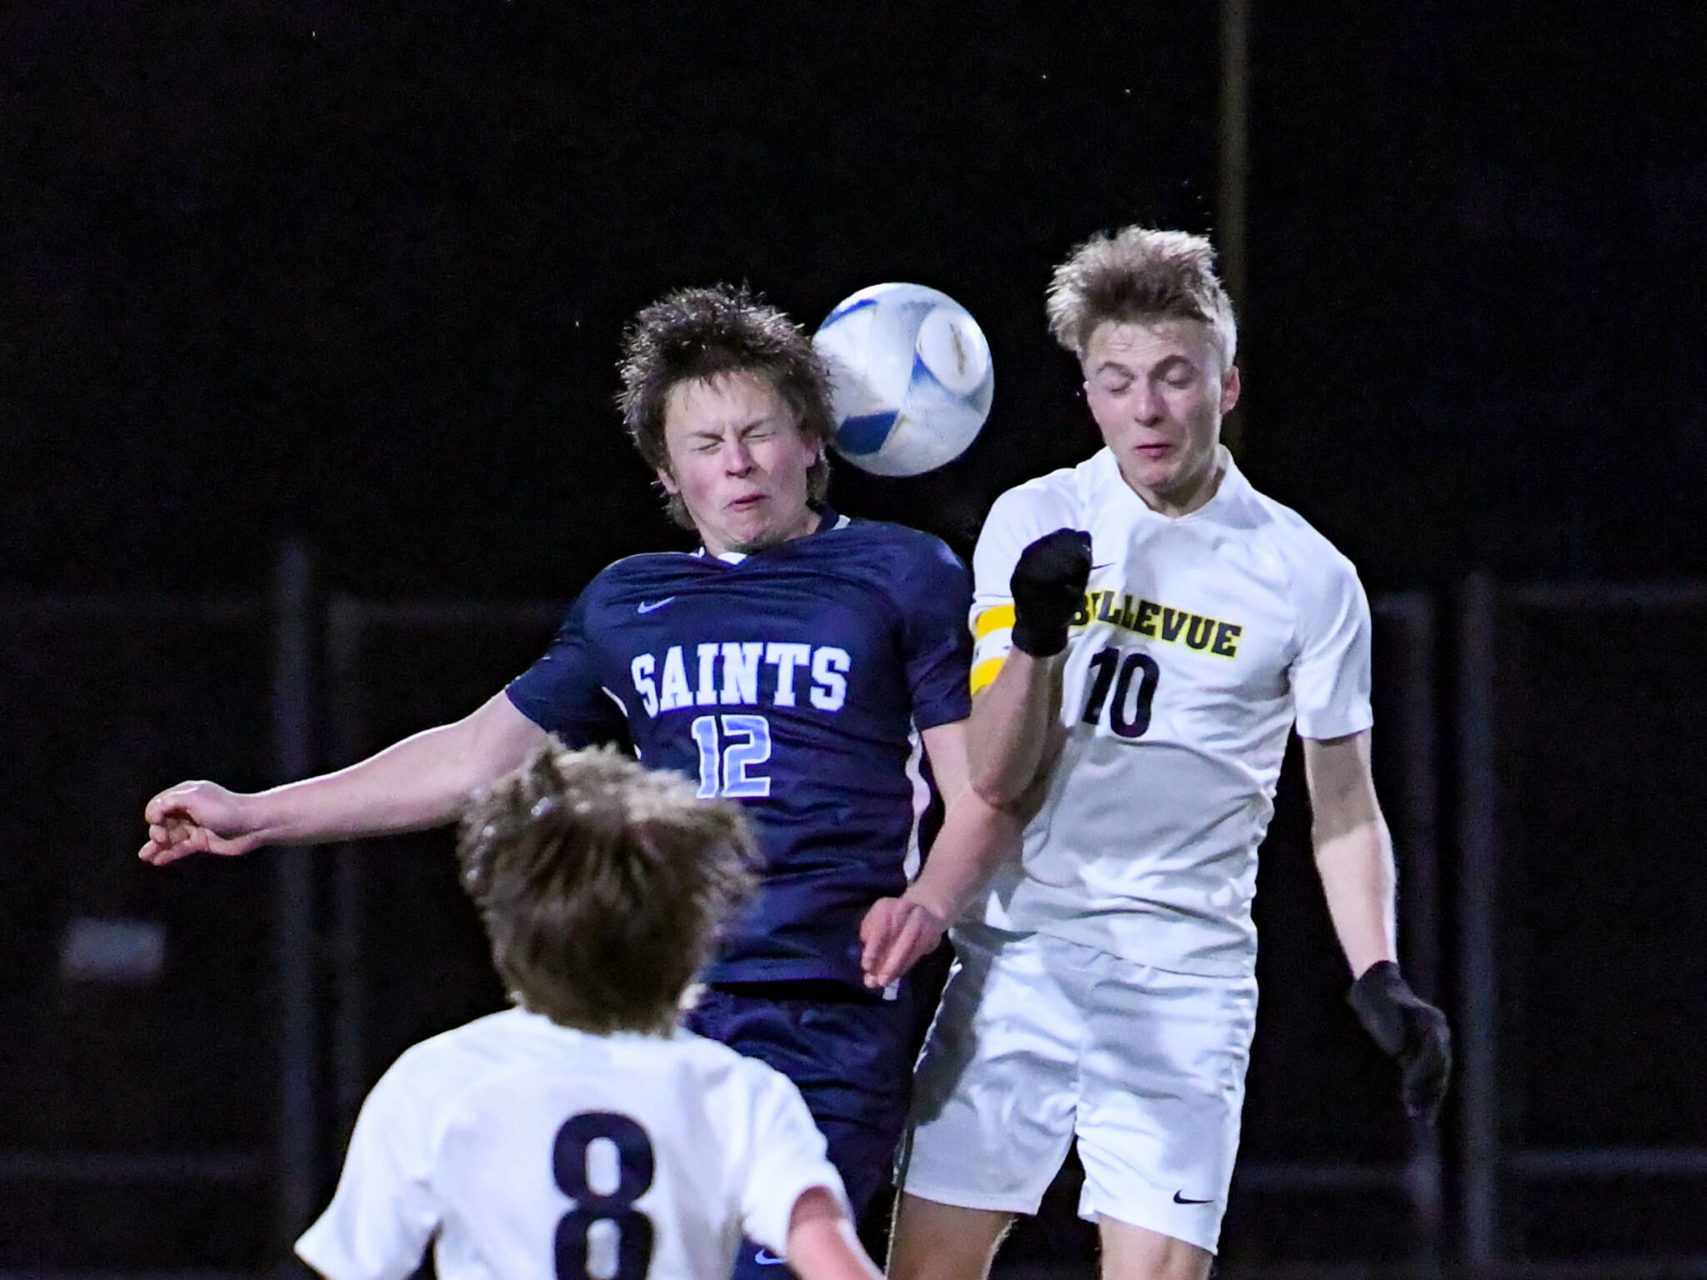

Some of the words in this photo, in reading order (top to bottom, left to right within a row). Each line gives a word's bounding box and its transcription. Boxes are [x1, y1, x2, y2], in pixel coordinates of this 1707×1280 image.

[631, 642, 851, 719] SAINTS
[1082, 645, 1160, 738] 10
[691, 714, 771, 799] 12
